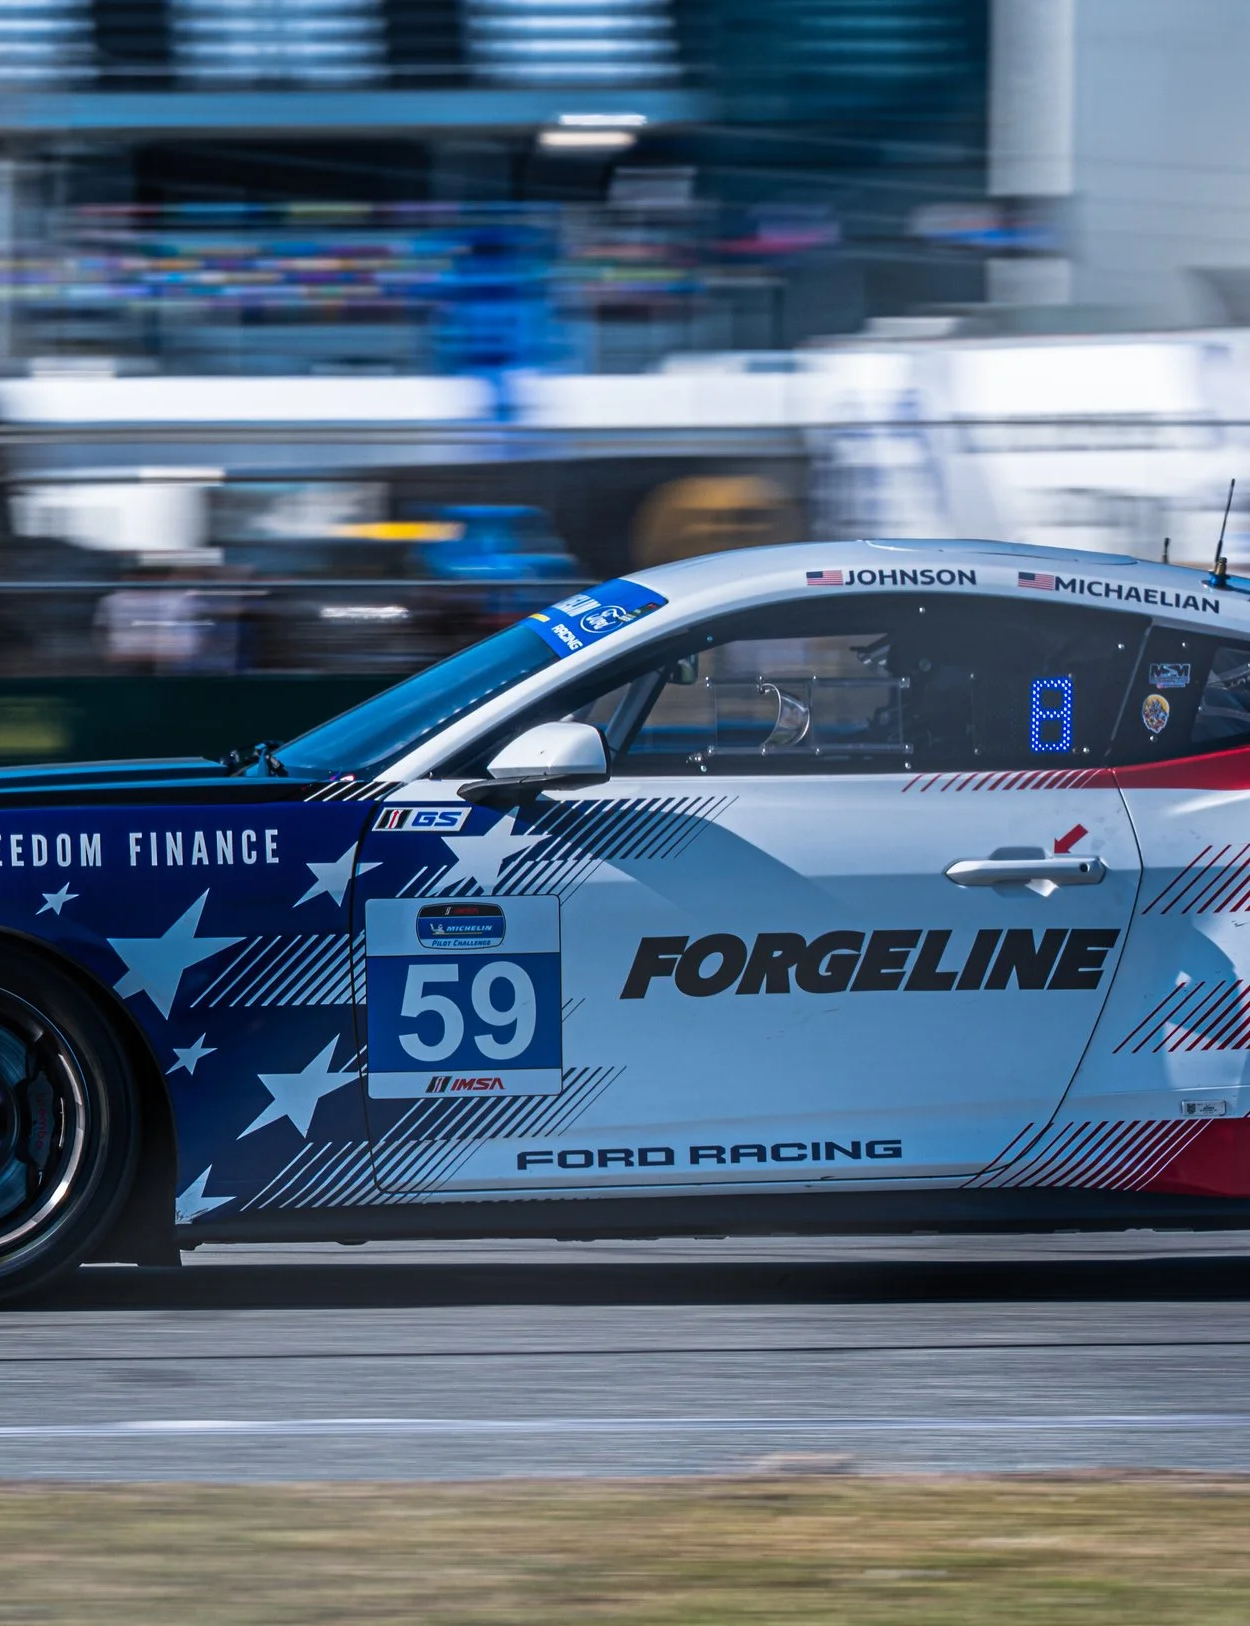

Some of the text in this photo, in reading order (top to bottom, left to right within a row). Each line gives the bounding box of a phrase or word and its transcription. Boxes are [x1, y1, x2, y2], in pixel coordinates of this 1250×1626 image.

[845, 569, 977, 586] JOHNSON
[1054, 576, 1220, 614] MICHAELIAN
[551, 624, 583, 650] RACING
[411, 811, 462, 826] GS
[129, 829, 280, 866] FINANCE
[619, 928, 1122, 1000] FORGELINE
[398, 961, 537, 1062] 59
[451, 1077, 505, 1091] IMSA
[517, 1139, 903, 1170] FORD RACING
